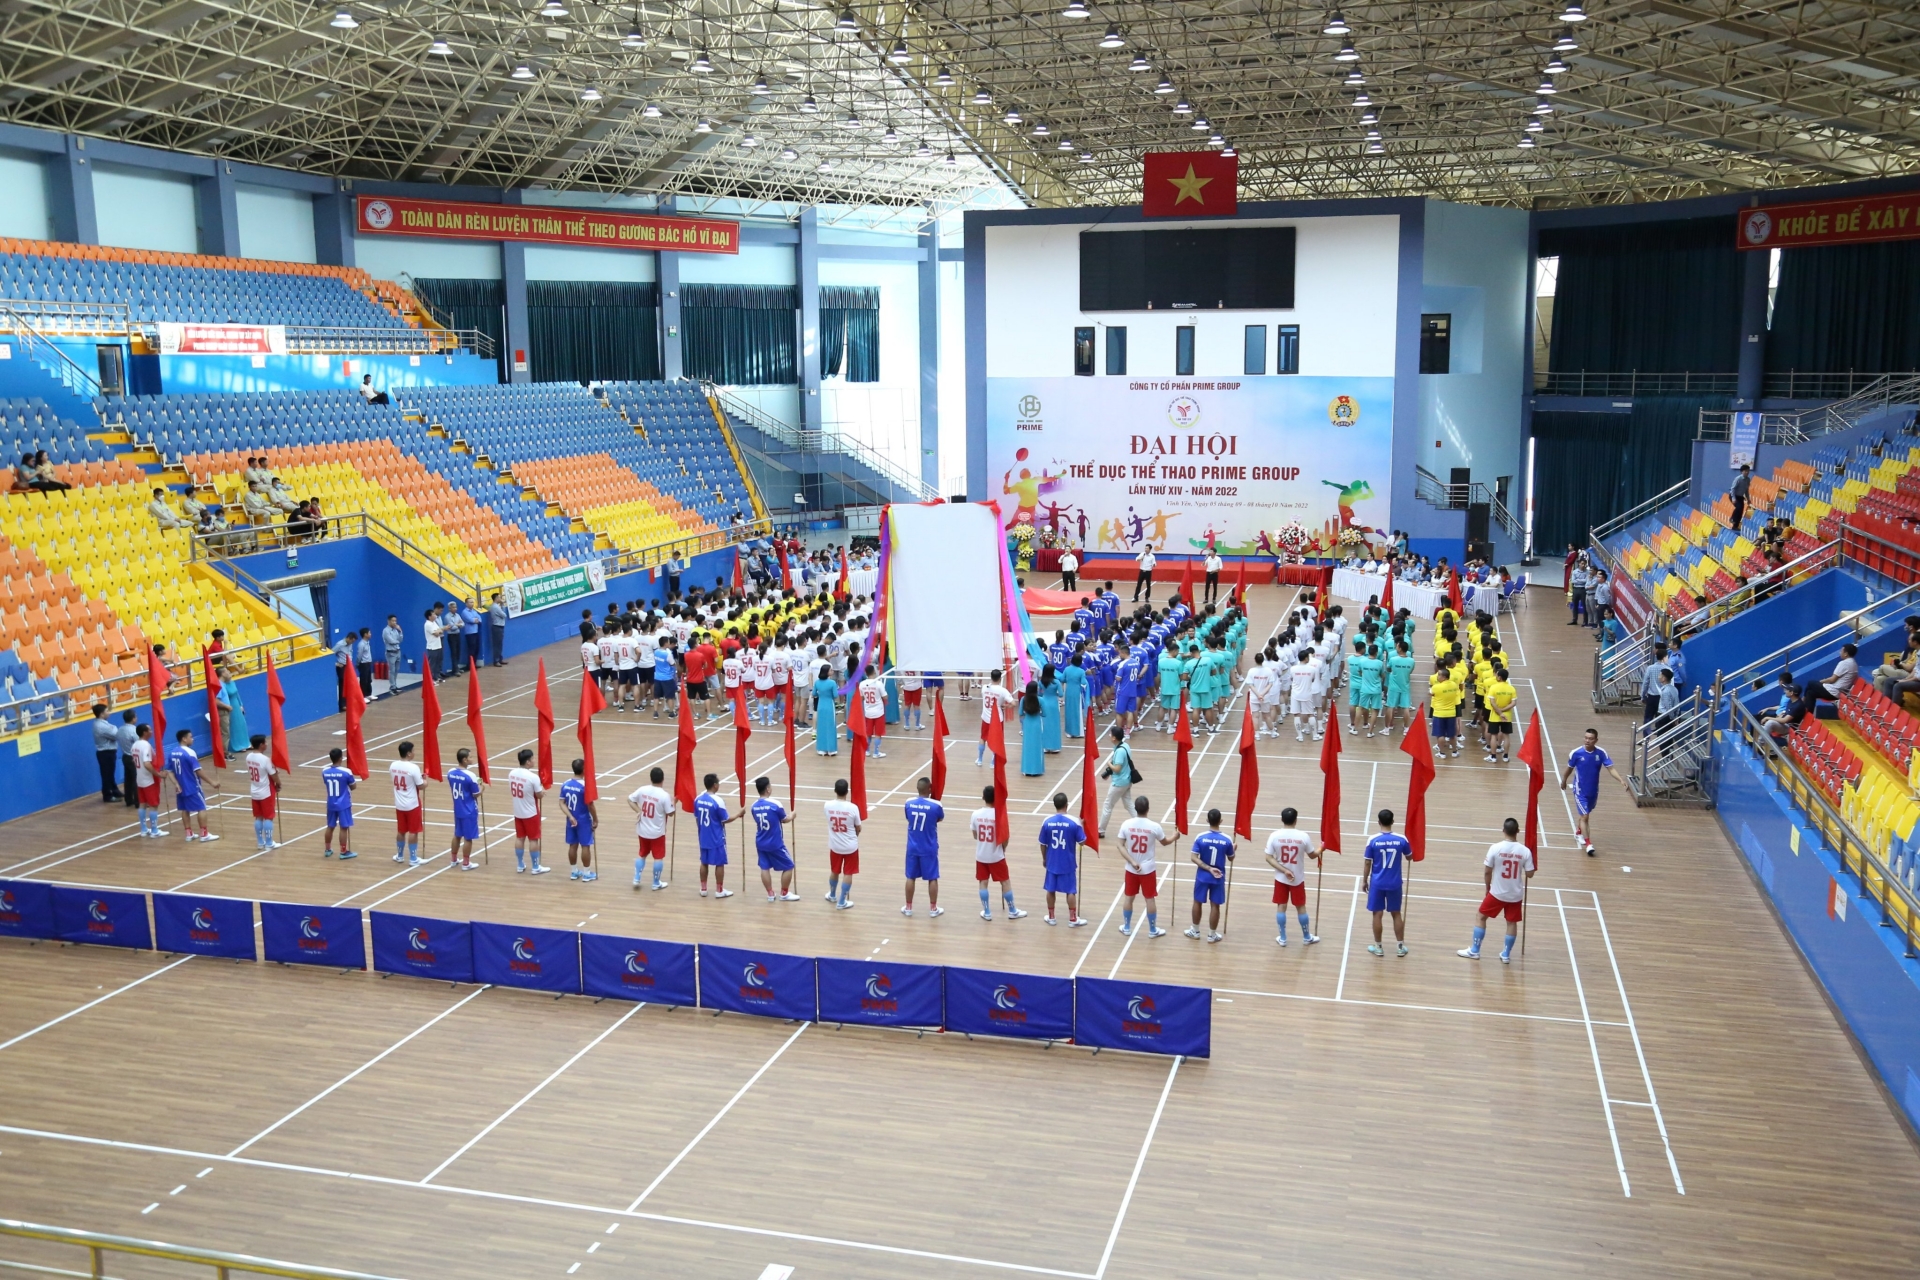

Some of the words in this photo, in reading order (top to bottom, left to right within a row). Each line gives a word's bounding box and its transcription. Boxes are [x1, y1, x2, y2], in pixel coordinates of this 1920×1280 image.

[1778, 210, 1829, 237] KHỎE
[1835, 204, 1863, 233] ĐỂ
[1867, 205, 1909, 231] XÂY
[401, 209, 433, 227] TOÀN
[437, 211, 462, 229] DÂN
[466, 212, 489, 231] RÈN
[493, 214, 528, 235] LUYỆN
[532, 217, 561, 235] THÂN
[565, 217, 585, 237] THỂ
[589, 223, 615, 239] THEO
[619, 225, 655, 242] GƯƠNG
[659, 226, 679, 243] BÁC
[683, 225, 696, 243] HỒ
[700, 228, 710, 244] VĨ
[712, 231, 729, 249] ĐẠI
[1130, 381, 1148, 390] CÔNG
[1193, 382, 1215, 390] PRIME
[1217, 382, 1241, 390] GROUP
[1130, 435, 1178, 460] ĐẠI
[1186, 432, 1238, 460] HỘI
[1070, 459, 1095, 478] THỂ
[1100, 465, 1126, 481] DỤC
[1132, 459, 1158, 479] THỂ
[1161, 466, 1196, 479] THAO
[1202, 466, 1246, 480] PRIME
[1252, 467, 1300, 480] GROUP
[1149, 484, 1166, 495] THỨ
[1168, 486, 1183, 495] XIV
[1192, 485, 1212, 496] NĂM
[1215, 487, 1237, 496] 2022
[1095, 608, 1102, 618] 61
[680, 631, 685, 640] 6
[602, 646, 610, 656] 13
[1054, 652, 1062, 664] 60
[742, 656, 753, 668] 54
[792, 659, 802, 671] 29
[726, 669, 736, 680] 49
[757, 665, 768, 677] 57
[1130, 668, 1138, 682] 69
[864, 692, 875, 704] 36
[249, 767, 260, 782] 38
[327, 779, 340, 797] 11
[394, 775, 407, 791] 44
[453, 782, 464, 800] 64
[511, 781, 524, 799] 66
[566, 792, 577, 811] 29
[642, 801, 655, 819] 40
[699, 808, 711, 828] 73
[756, 813, 770, 831] 75
[830, 817, 848, 833] 35
[912, 812, 927, 831] 77
[979, 824, 994, 843] 63
[1051, 830, 1066, 849] 54
[1130, 835, 1148, 853] 26
[1281, 845, 1298, 864] 62
[1380, 848, 1397, 869] 17
[1501, 860, 1519, 879] 31
[190, 930, 220, 941] SWIN
[298, 938, 328, 950] SWIN
[740, 986, 775, 999] SWIN
[860, 998, 897, 1012] SWIN
[989, 1008, 1026, 1022] SWIN
[1122, 1019, 1162, 1034] SWIN
